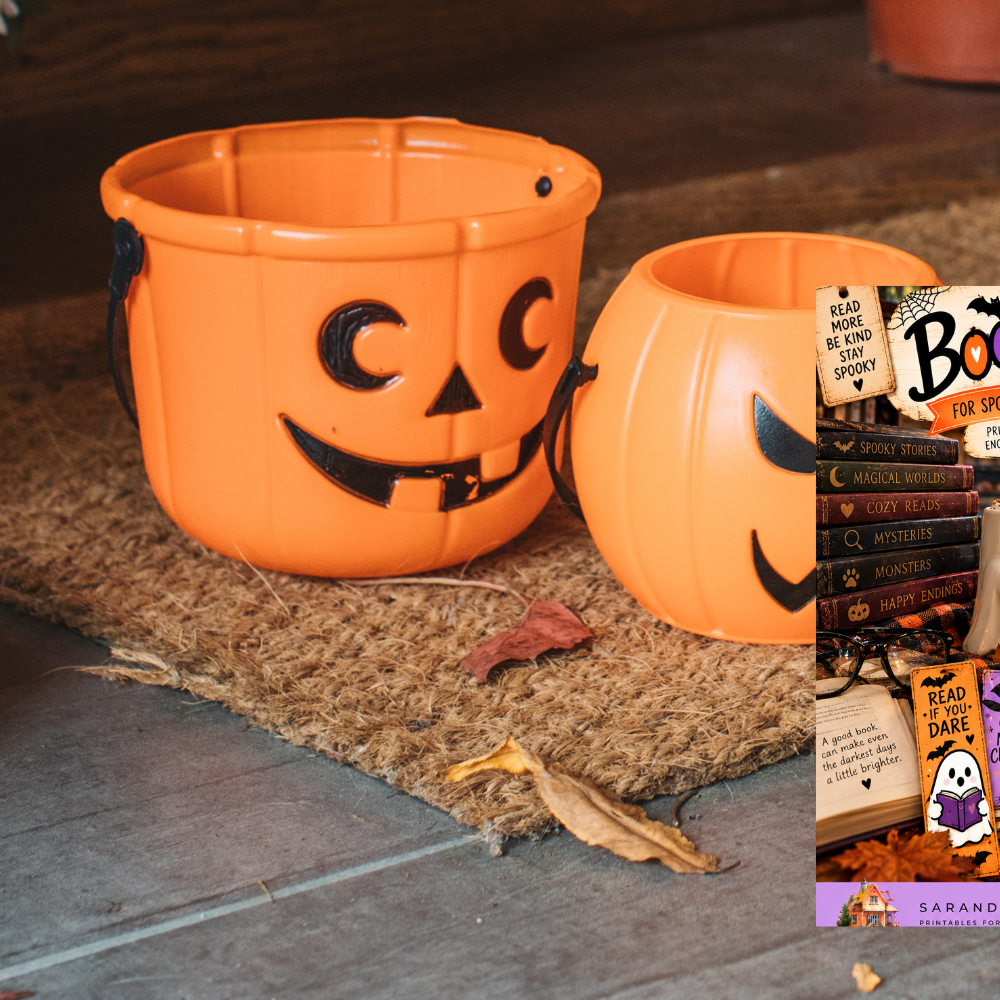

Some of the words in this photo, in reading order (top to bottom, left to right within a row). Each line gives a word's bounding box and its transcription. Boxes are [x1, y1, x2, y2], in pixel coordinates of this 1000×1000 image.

[860, 442, 896, 454] SPOOKY
[900, 444, 936, 456] STORIES
[854, 472, 900, 484] MAGICAL
[905, 472, 946, 484] WORLDS
[866, 501, 898, 514] COZY
[905, 500, 940, 512] READS
[822, 738, 828, 746] A
[832, 730, 853, 746] good
[855, 723, 878, 736] book
[822, 749, 838, 758] can
[841, 740, 864, 753] make
[868, 734, 888, 744] even
[822, 761, 837, 772] the
[840, 749, 873, 766] darkest
[876, 742, 896, 754] days
[836, 767, 858, 781] little
[860, 756, 902, 772] brighter.
